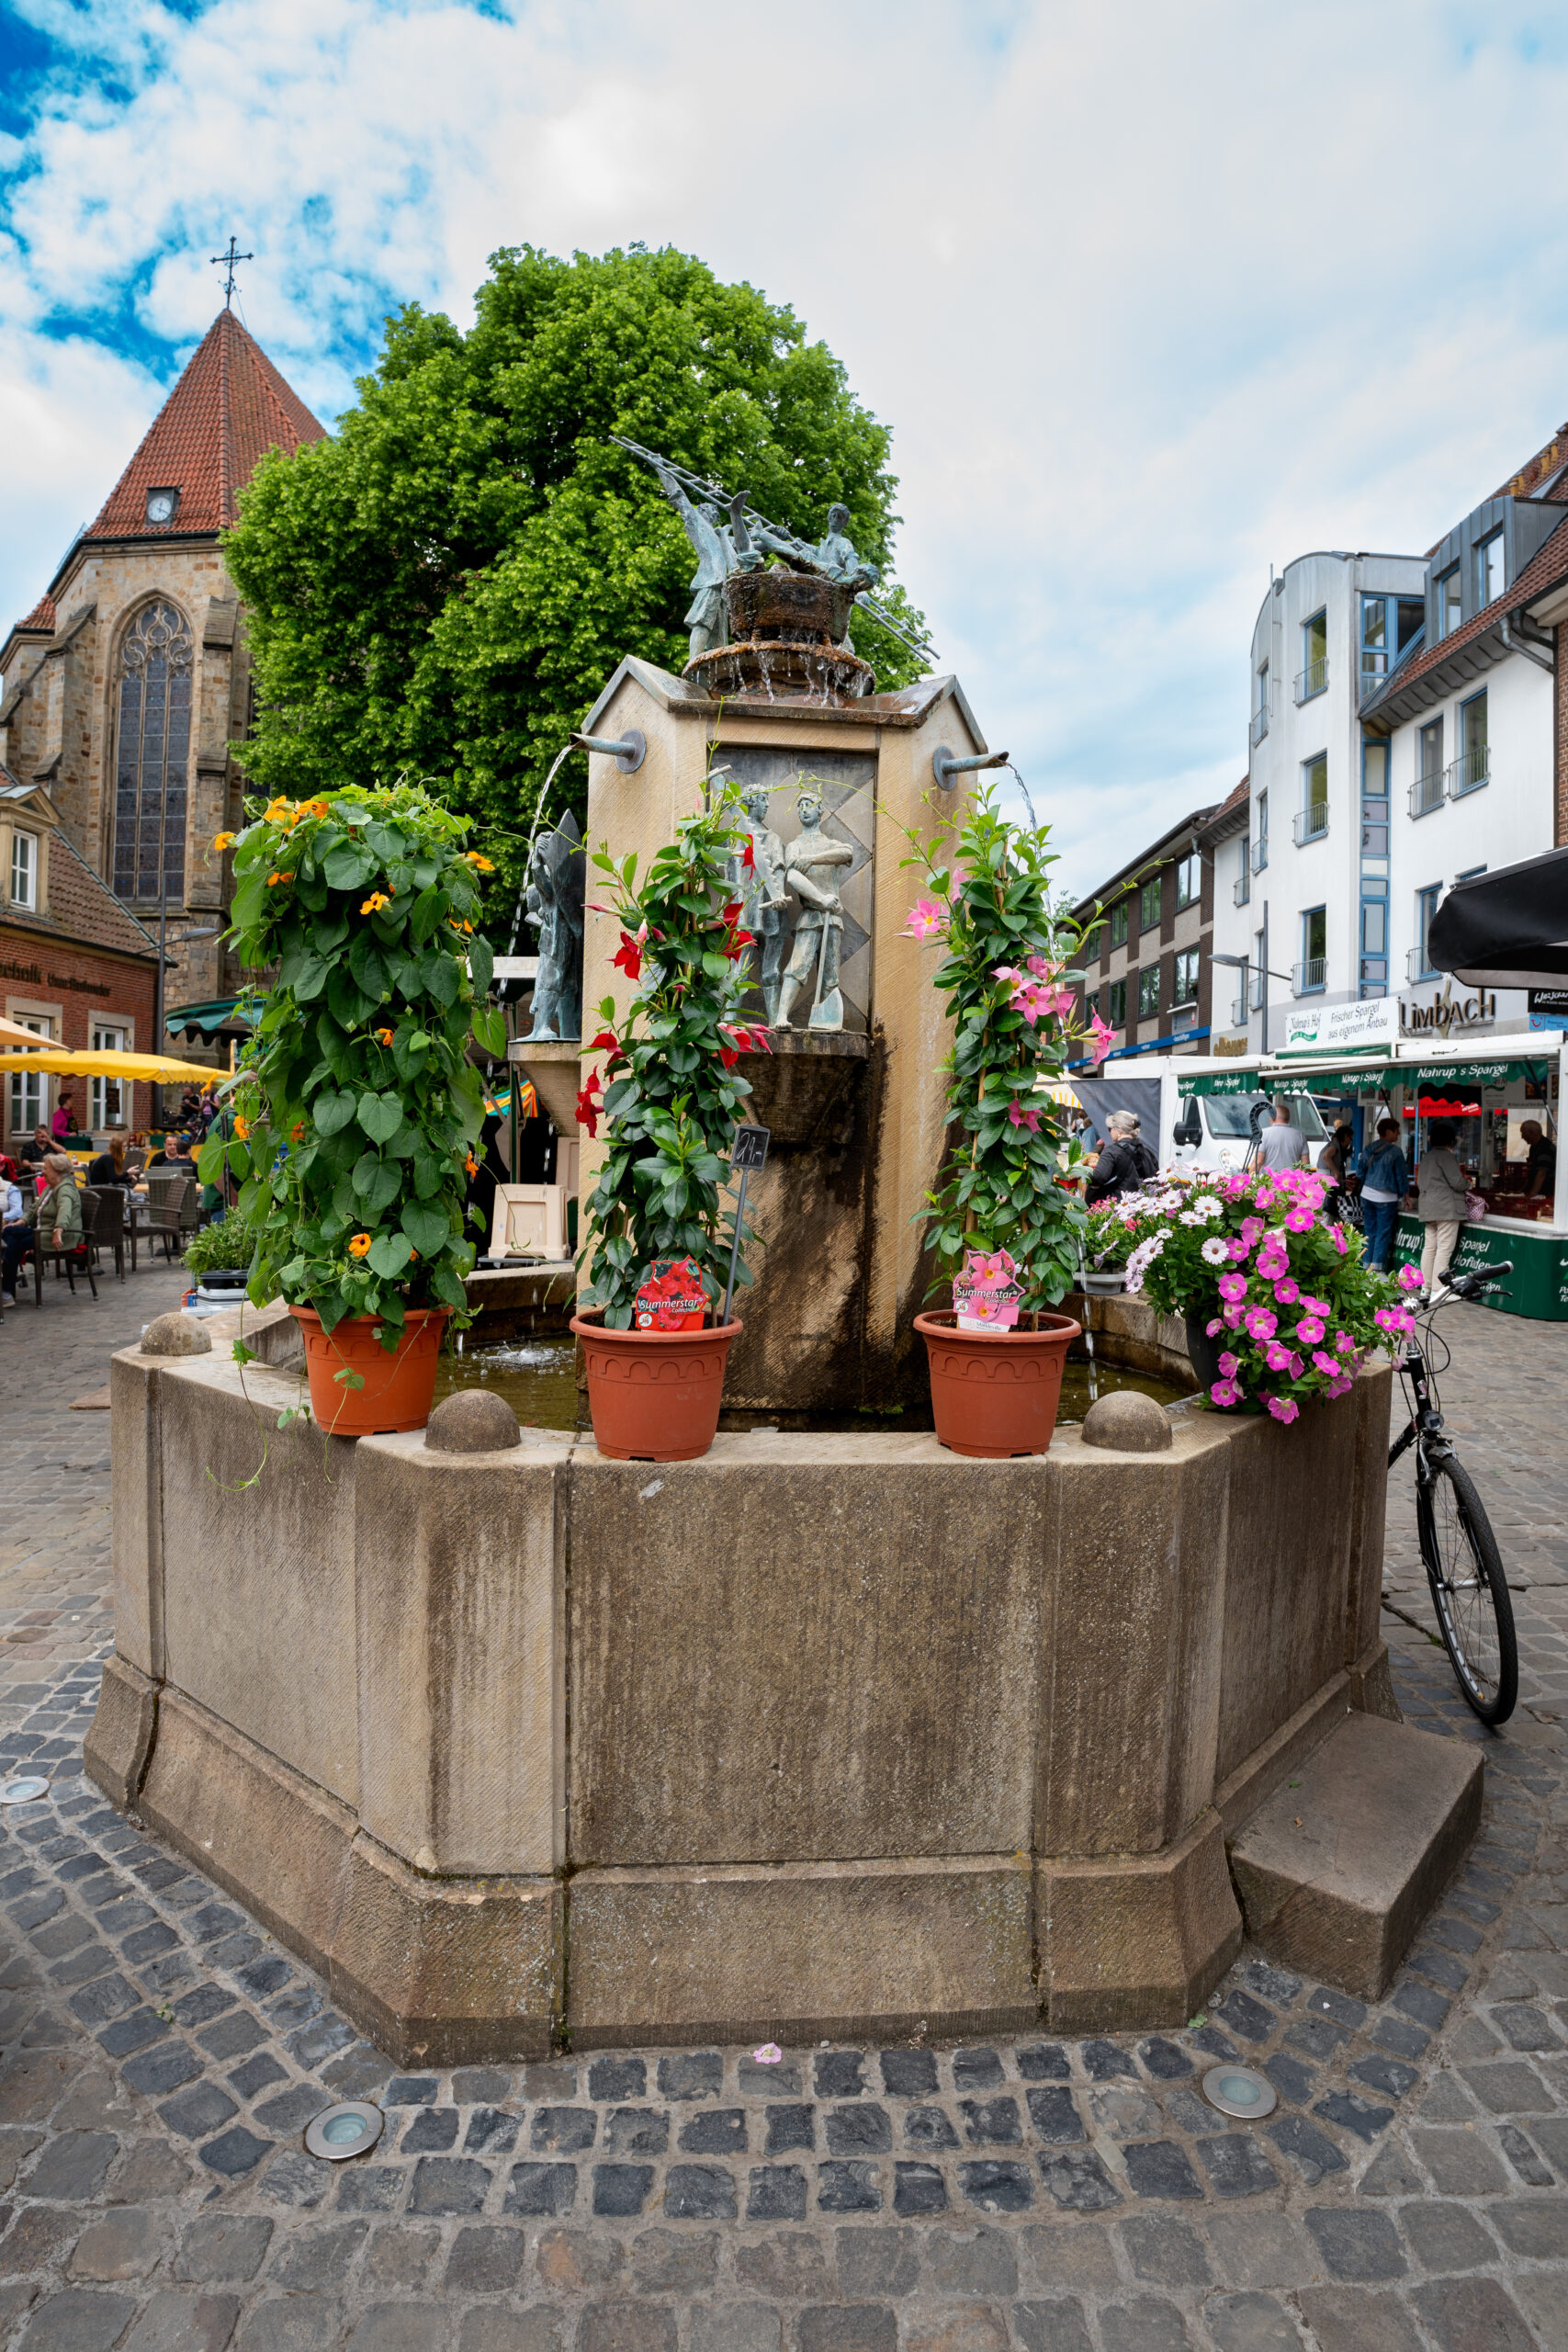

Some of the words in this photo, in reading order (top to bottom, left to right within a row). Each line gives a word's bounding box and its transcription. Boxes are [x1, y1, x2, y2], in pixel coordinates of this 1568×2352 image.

[1331, 1011, 1354, 1023] Frischer
[1355, 1001, 1381, 1018] Spargel
[1327, 1029, 1337, 1039] aus
[1338, 1023, 1365, 1040] eigenem
[1366, 1017, 1388, 1029] Anbau
[1469, 1063, 1509, 1078] Spargel
